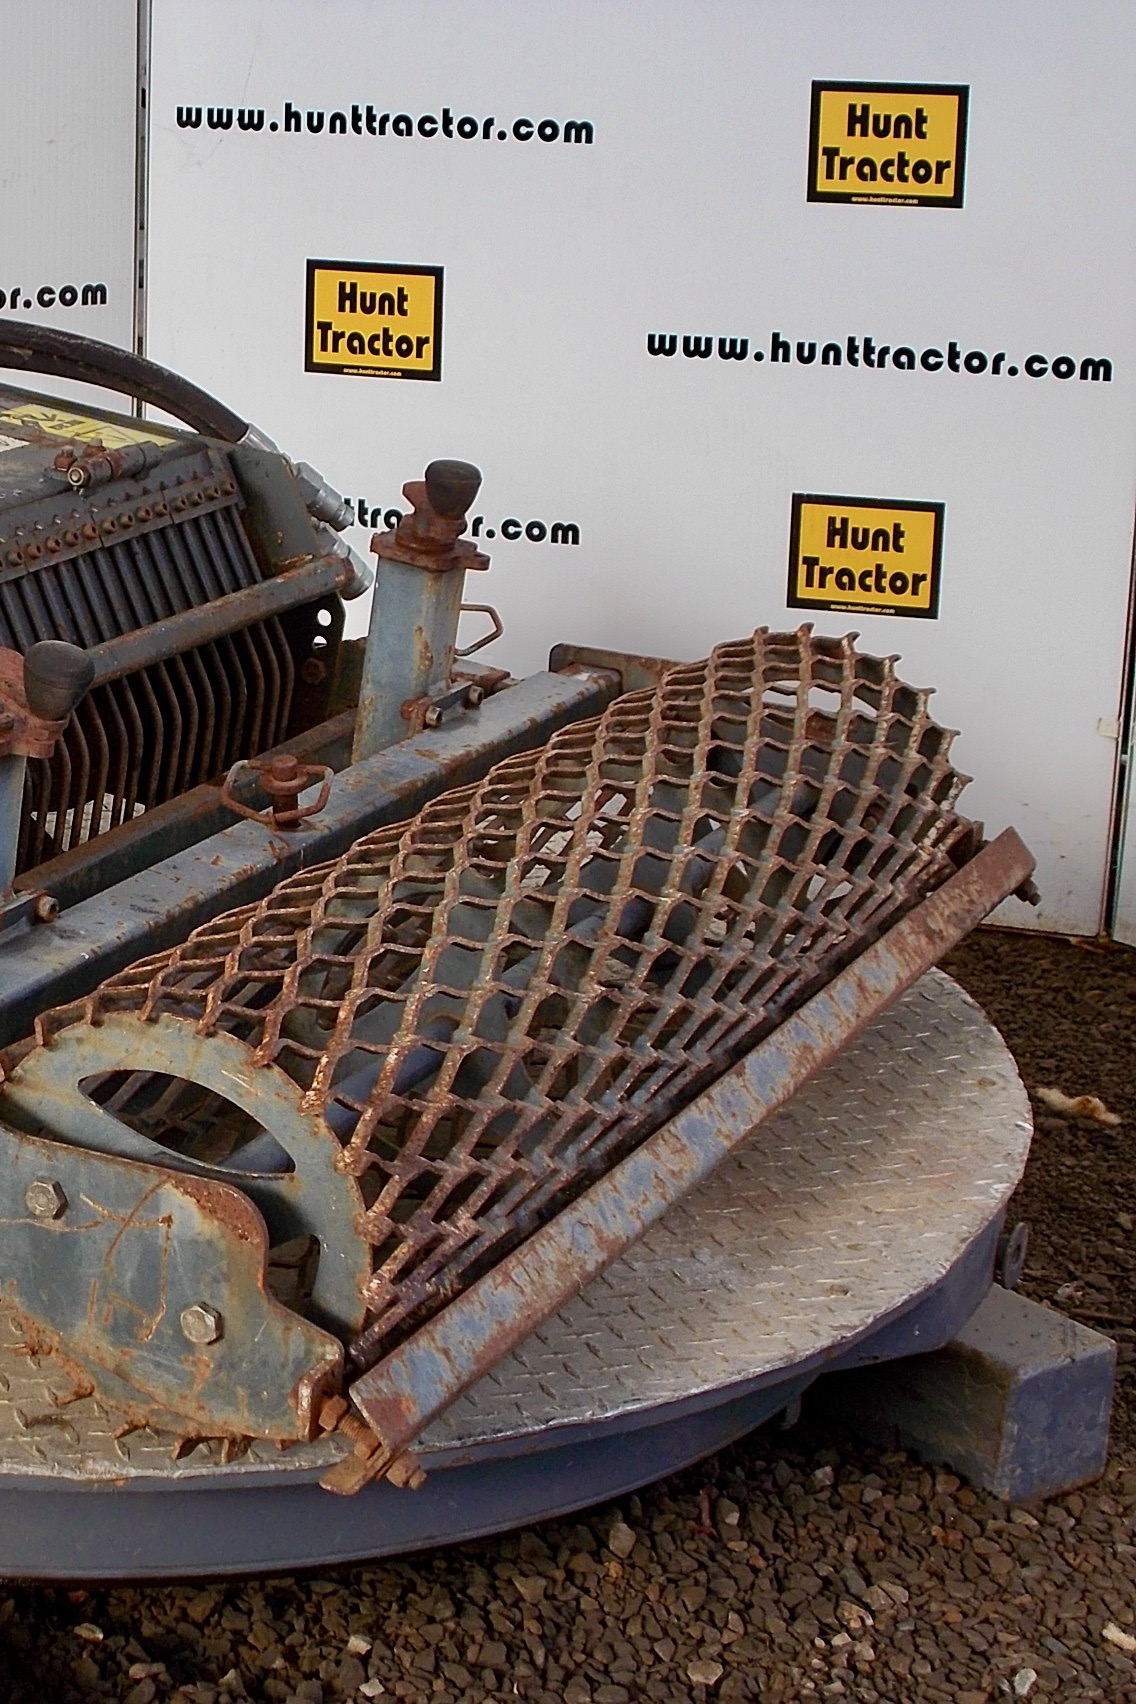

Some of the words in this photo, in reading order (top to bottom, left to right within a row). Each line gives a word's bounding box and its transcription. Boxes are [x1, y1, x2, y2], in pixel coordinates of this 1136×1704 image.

[176, 103, 594, 144] www.hunttractor.com
[847, 103, 928, 139] Hunt
[821, 147, 952, 185] Tractor
[337, 281, 409, 317] Hunt
[316, 320, 430, 359] Tractor
[648, 332, 1112, 382] www.hunttractor.com
[826, 516, 906, 553] Hunt
[802, 556, 928, 596] Tractor
